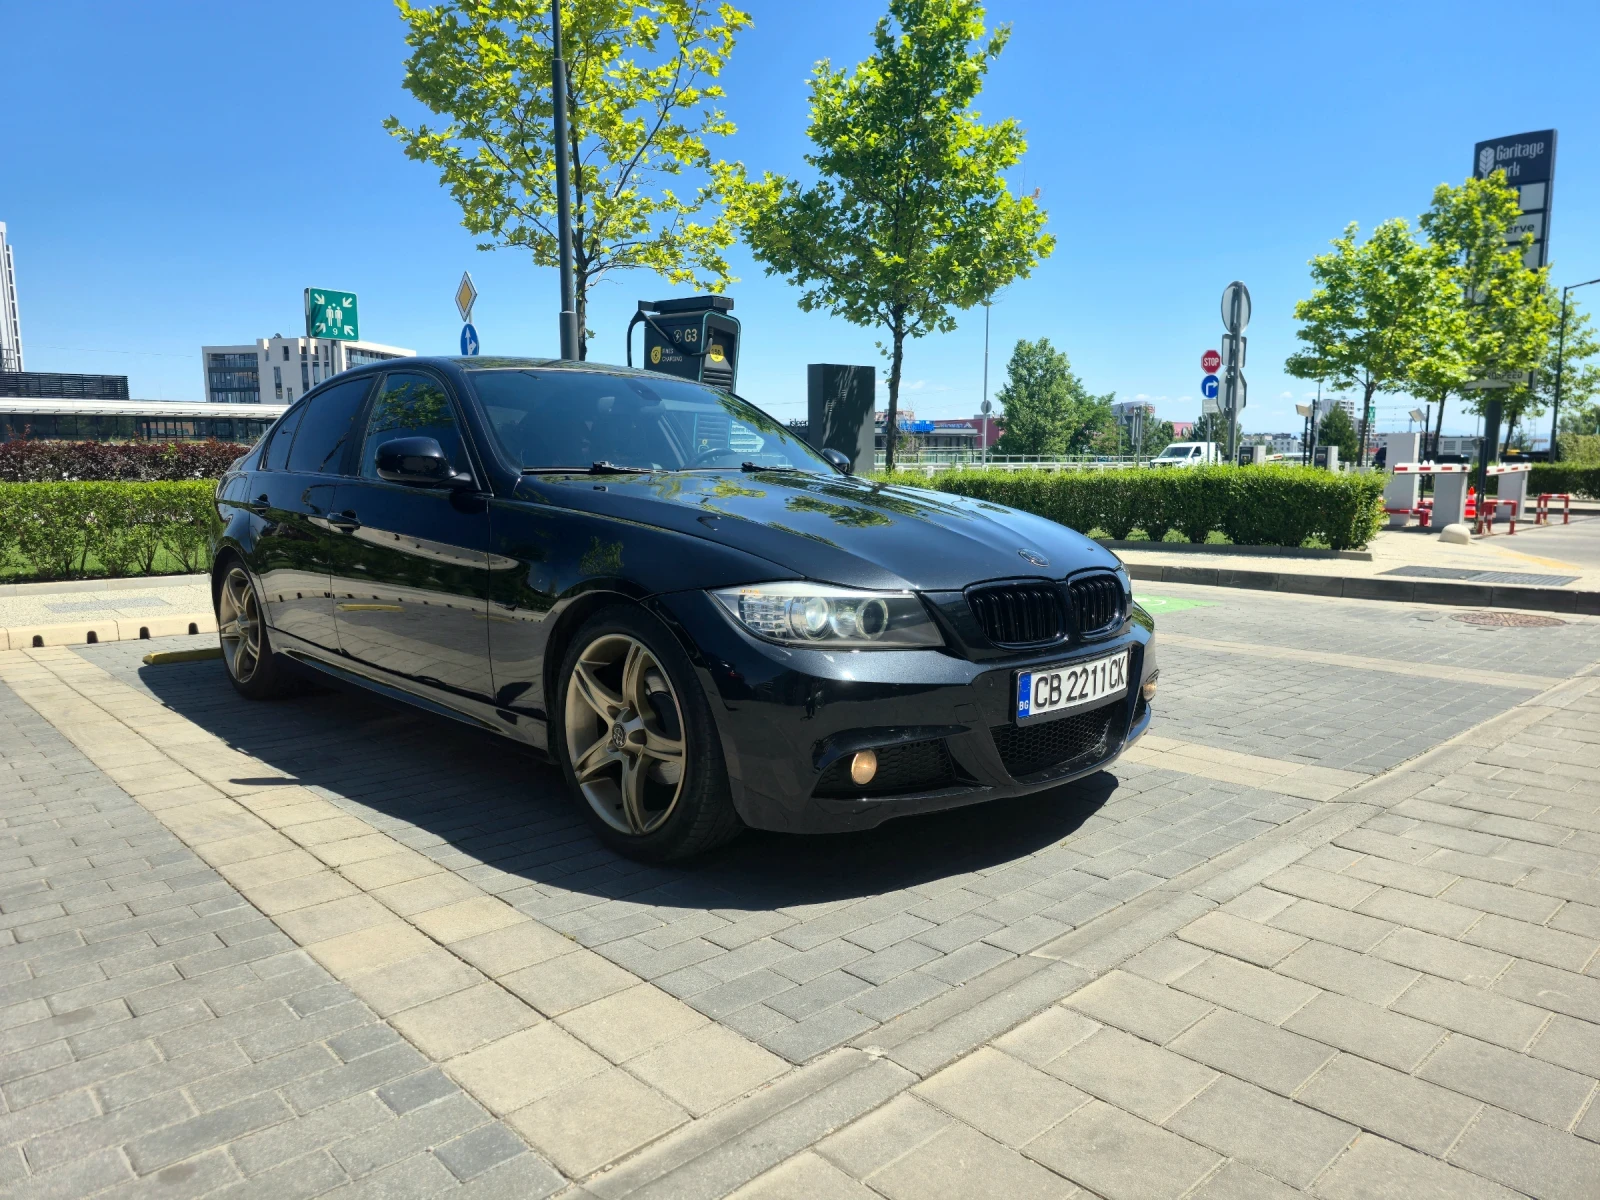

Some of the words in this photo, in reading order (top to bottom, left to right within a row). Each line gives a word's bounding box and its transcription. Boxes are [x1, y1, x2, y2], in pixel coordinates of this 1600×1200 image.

[1496, 141, 1544, 160] Garitage
[332, 327, 338, 336] 9
[684, 328, 698, 342] G3
[1203, 357, 1220, 367] STOP
[1018, 700, 1029, 711] BG
